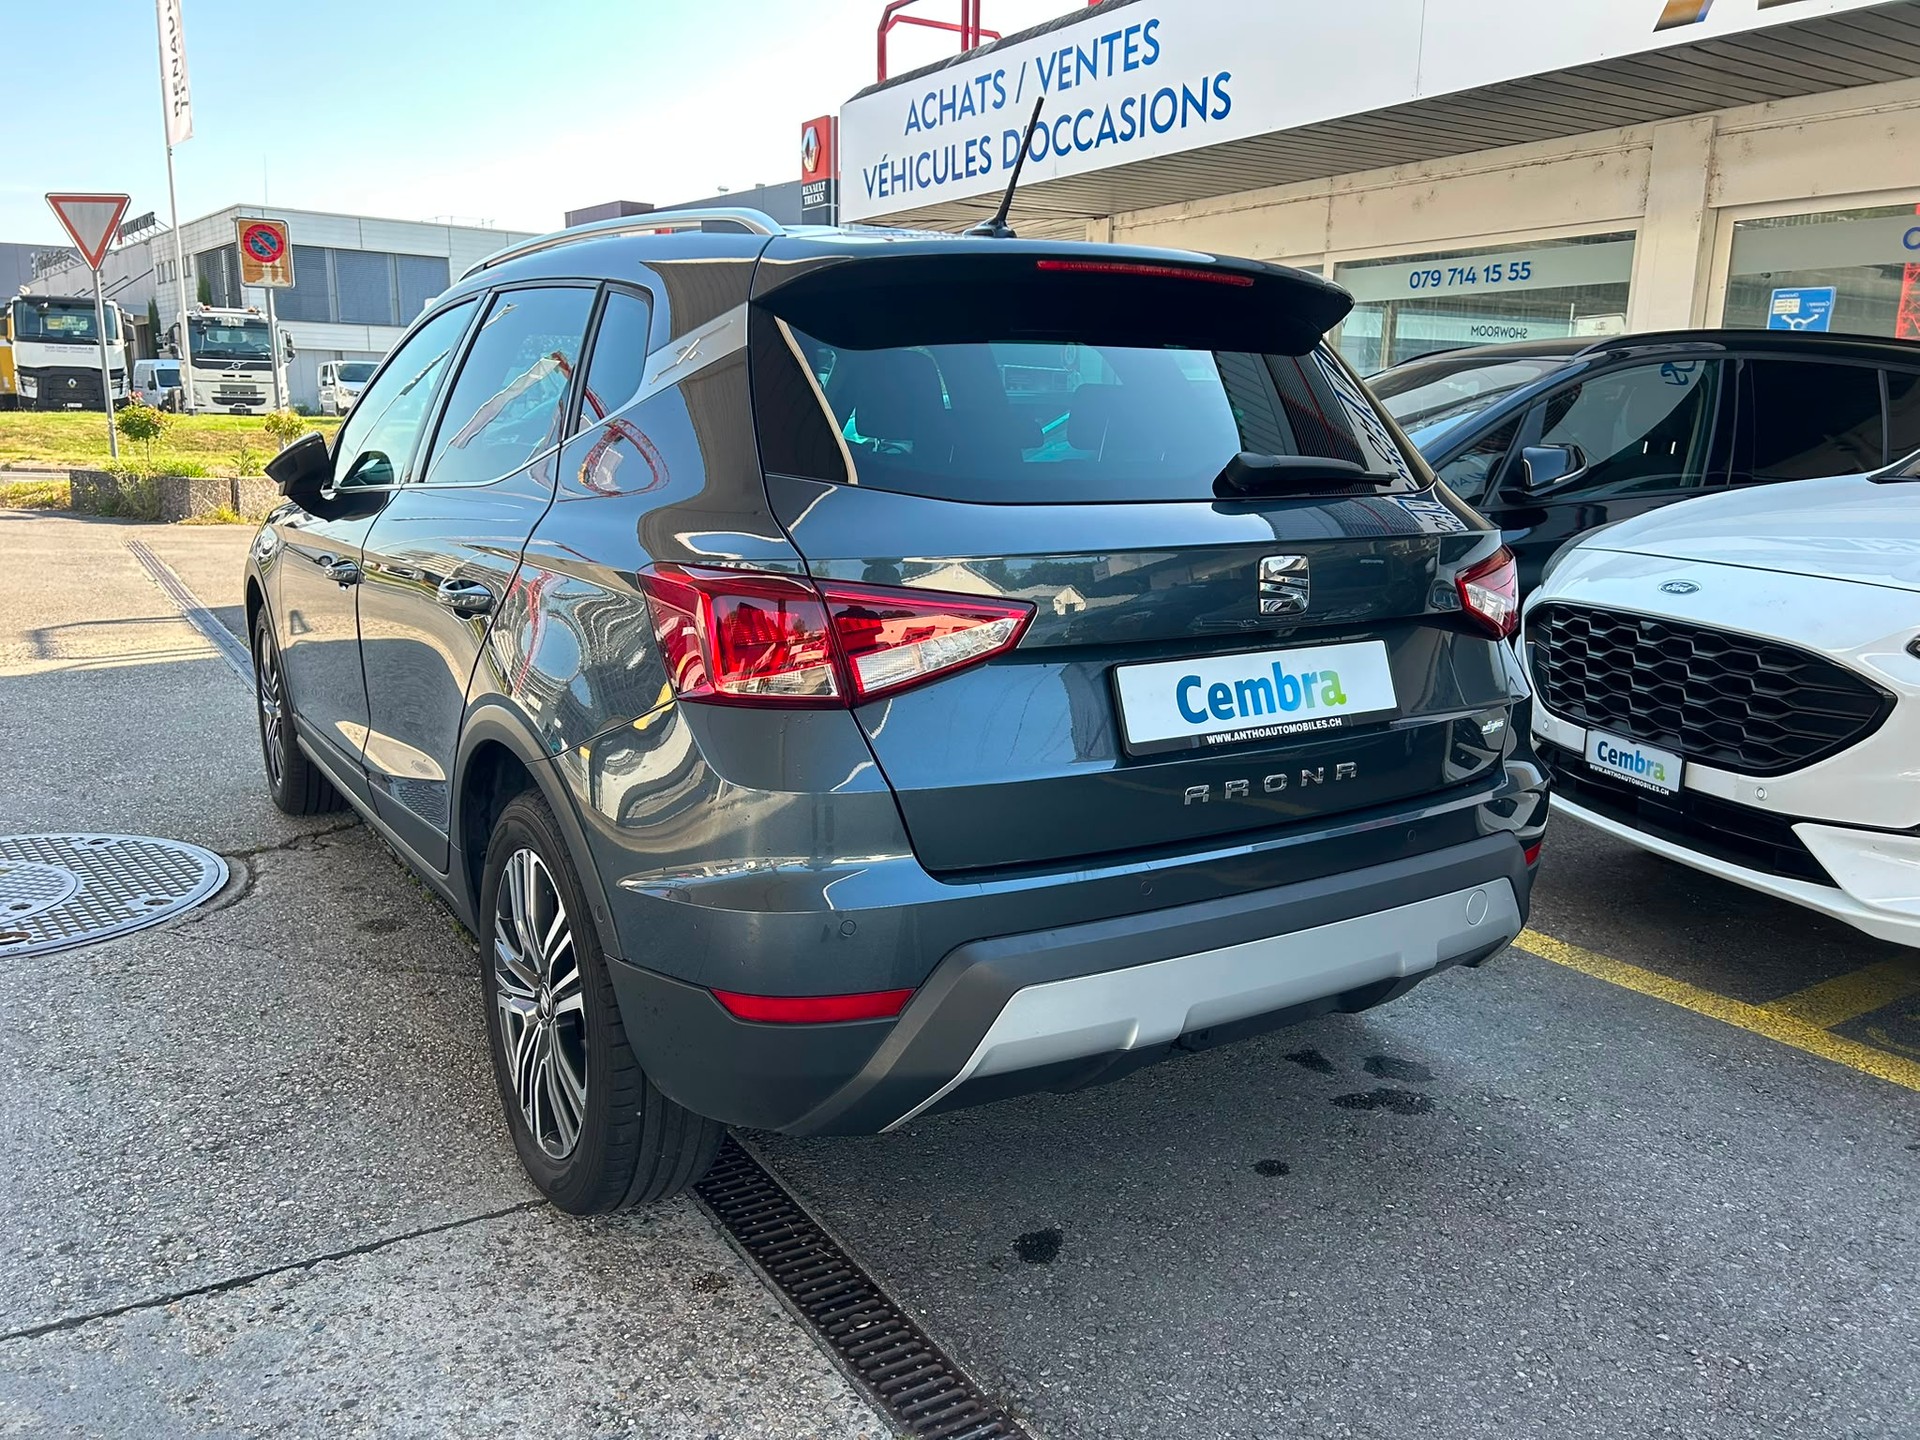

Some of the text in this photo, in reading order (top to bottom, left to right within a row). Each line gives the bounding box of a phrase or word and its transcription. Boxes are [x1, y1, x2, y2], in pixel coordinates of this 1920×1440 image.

[904, 18, 1161, 136] ACHATS / VENTES
[863, 71, 1232, 200] VÉHICULES D'OCCASIONS
[802, 181, 827, 196] RENAULT
[803, 192, 825, 206] TRUCKS
[1409, 261, 1531, 289] 079 714 15 55
[1175, 661, 1348, 725] Cembra
[1206, 717, 1343, 745] WWW.ANTHOAUTOMOBILES.CH
[1596, 740, 1666, 781] Cembra
[1183, 761, 1358, 806] ARONA
[1589, 763, 1670, 796] WWW.ANTHOAUTOMOBILES.CH
